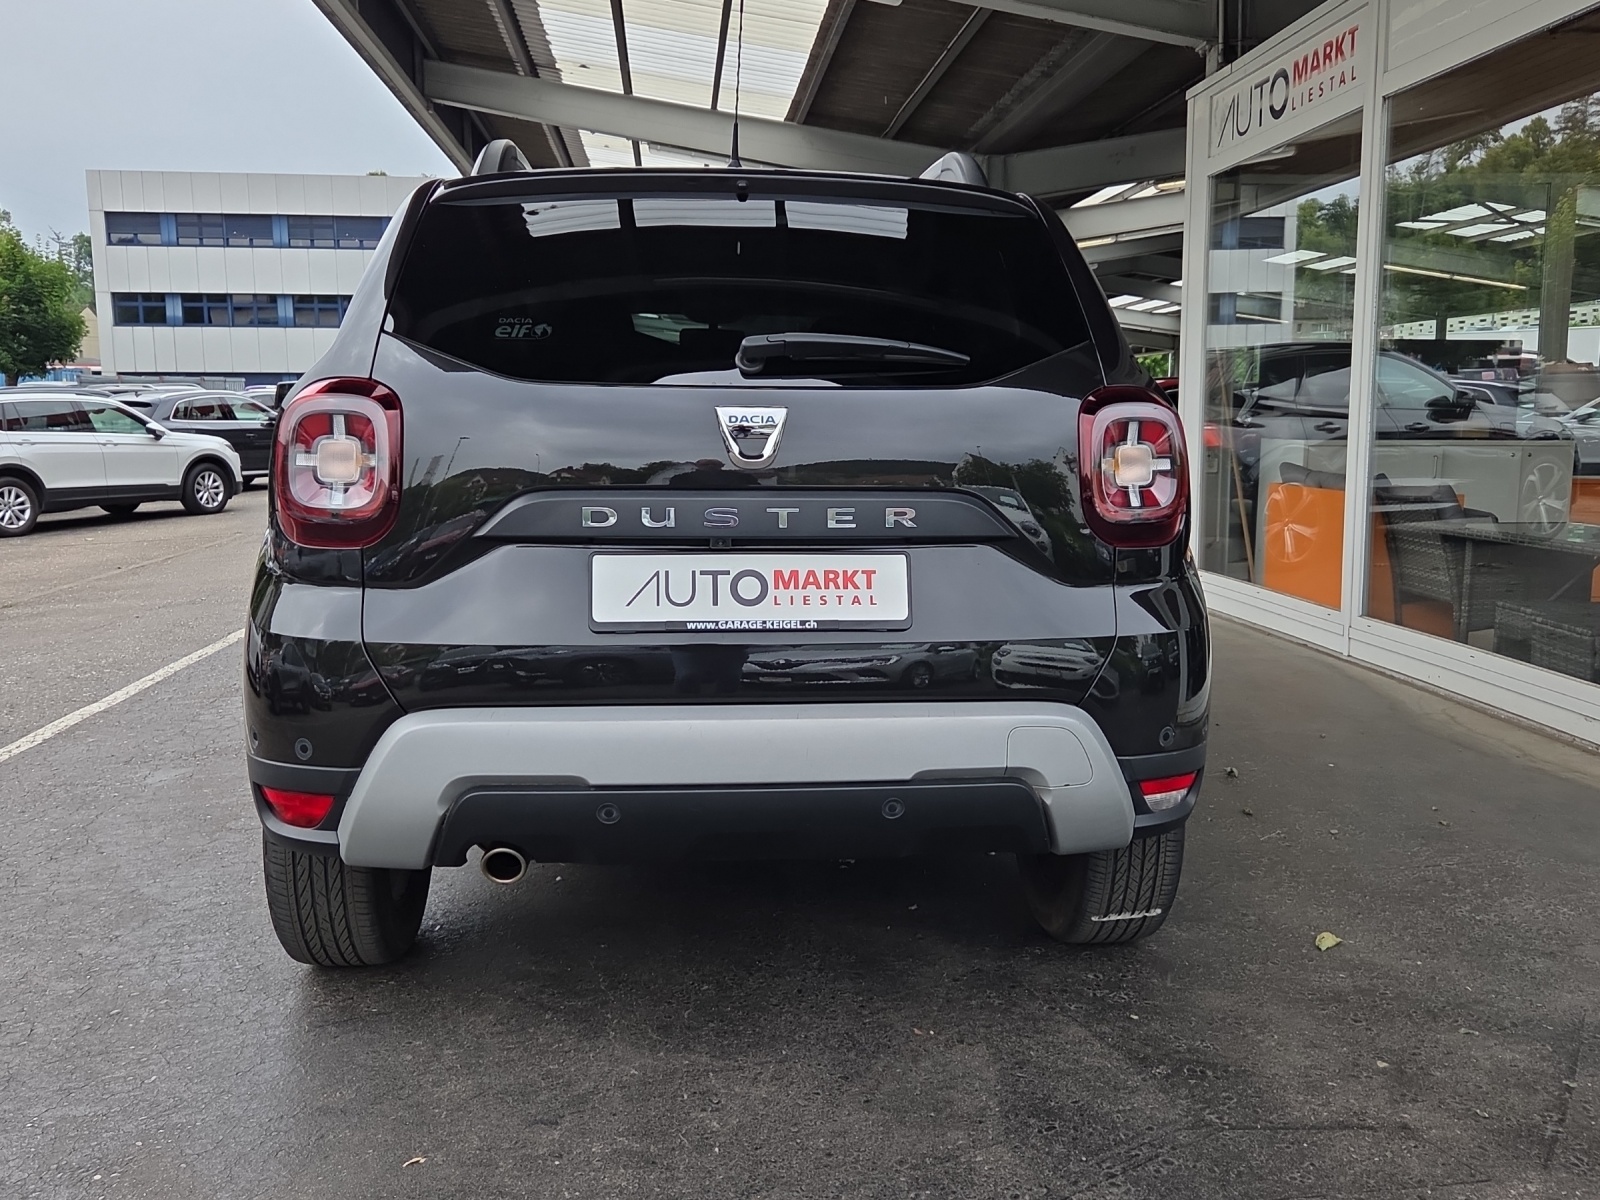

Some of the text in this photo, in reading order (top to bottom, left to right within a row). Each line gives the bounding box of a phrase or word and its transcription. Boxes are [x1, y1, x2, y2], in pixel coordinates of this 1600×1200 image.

[1217, 24, 1359, 148] AUTO MARKT
[1291, 65, 1357, 111] LIESTAL
[494, 324, 533, 338] elf
[727, 414, 776, 425] DACIA
[581, 506, 918, 529] DUSTER
[625, 568, 877, 607] AUTO MARKT
[773, 594, 878, 606] LIESTAL
[685, 620, 818, 630] www.GARAGE-KEIGEL.ch
